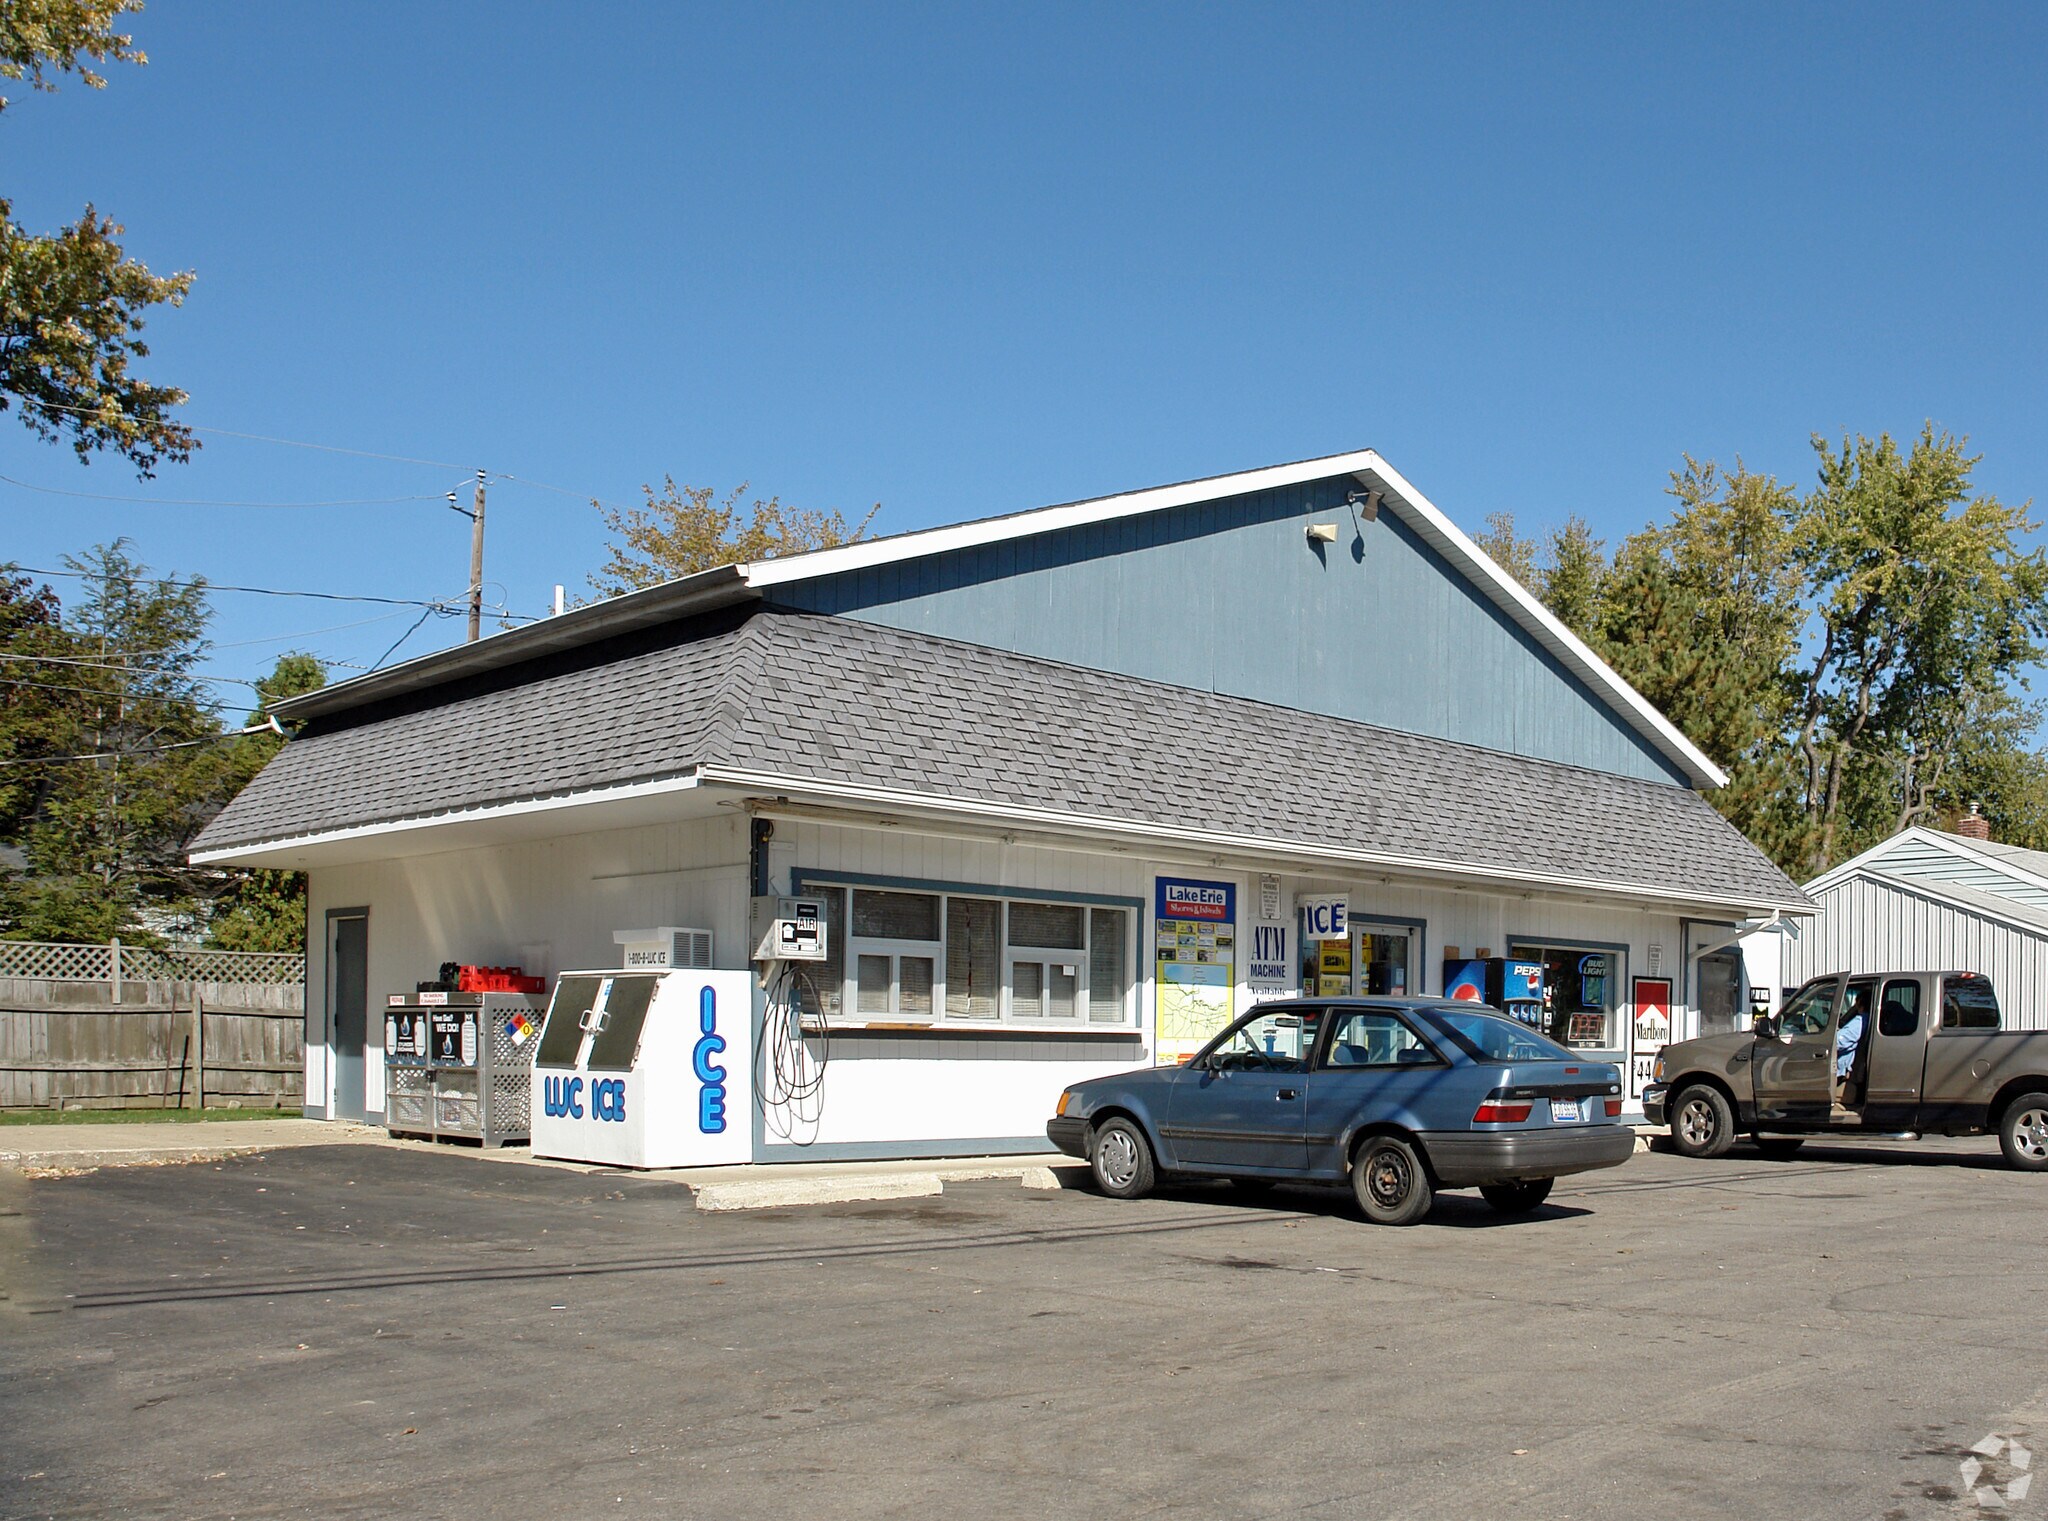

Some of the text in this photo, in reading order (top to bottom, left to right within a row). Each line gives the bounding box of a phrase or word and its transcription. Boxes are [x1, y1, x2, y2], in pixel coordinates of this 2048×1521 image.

[1169, 886, 1223, 904] Lake Erie
[798, 917, 815, 929] AIR
[1305, 900, 1346, 934] ICE
[1251, 925, 1286, 961] ATM
[657, 951, 666, 964] ICE
[1587, 959, 1605, 967] BUD
[1250, 963, 1286, 978] MACHINE
[1513, 965, 1542, 977] PEPS
[1249, 986, 1287, 996] Available
[436, 1023, 460, 1033] WE DO!
[523, 1025, 530, 1036] 0
[1636, 1018, 1668, 1040] Marlboro
[692, 985, 727, 1134] ICE
[544, 1075, 626, 1122] LUC ICE
